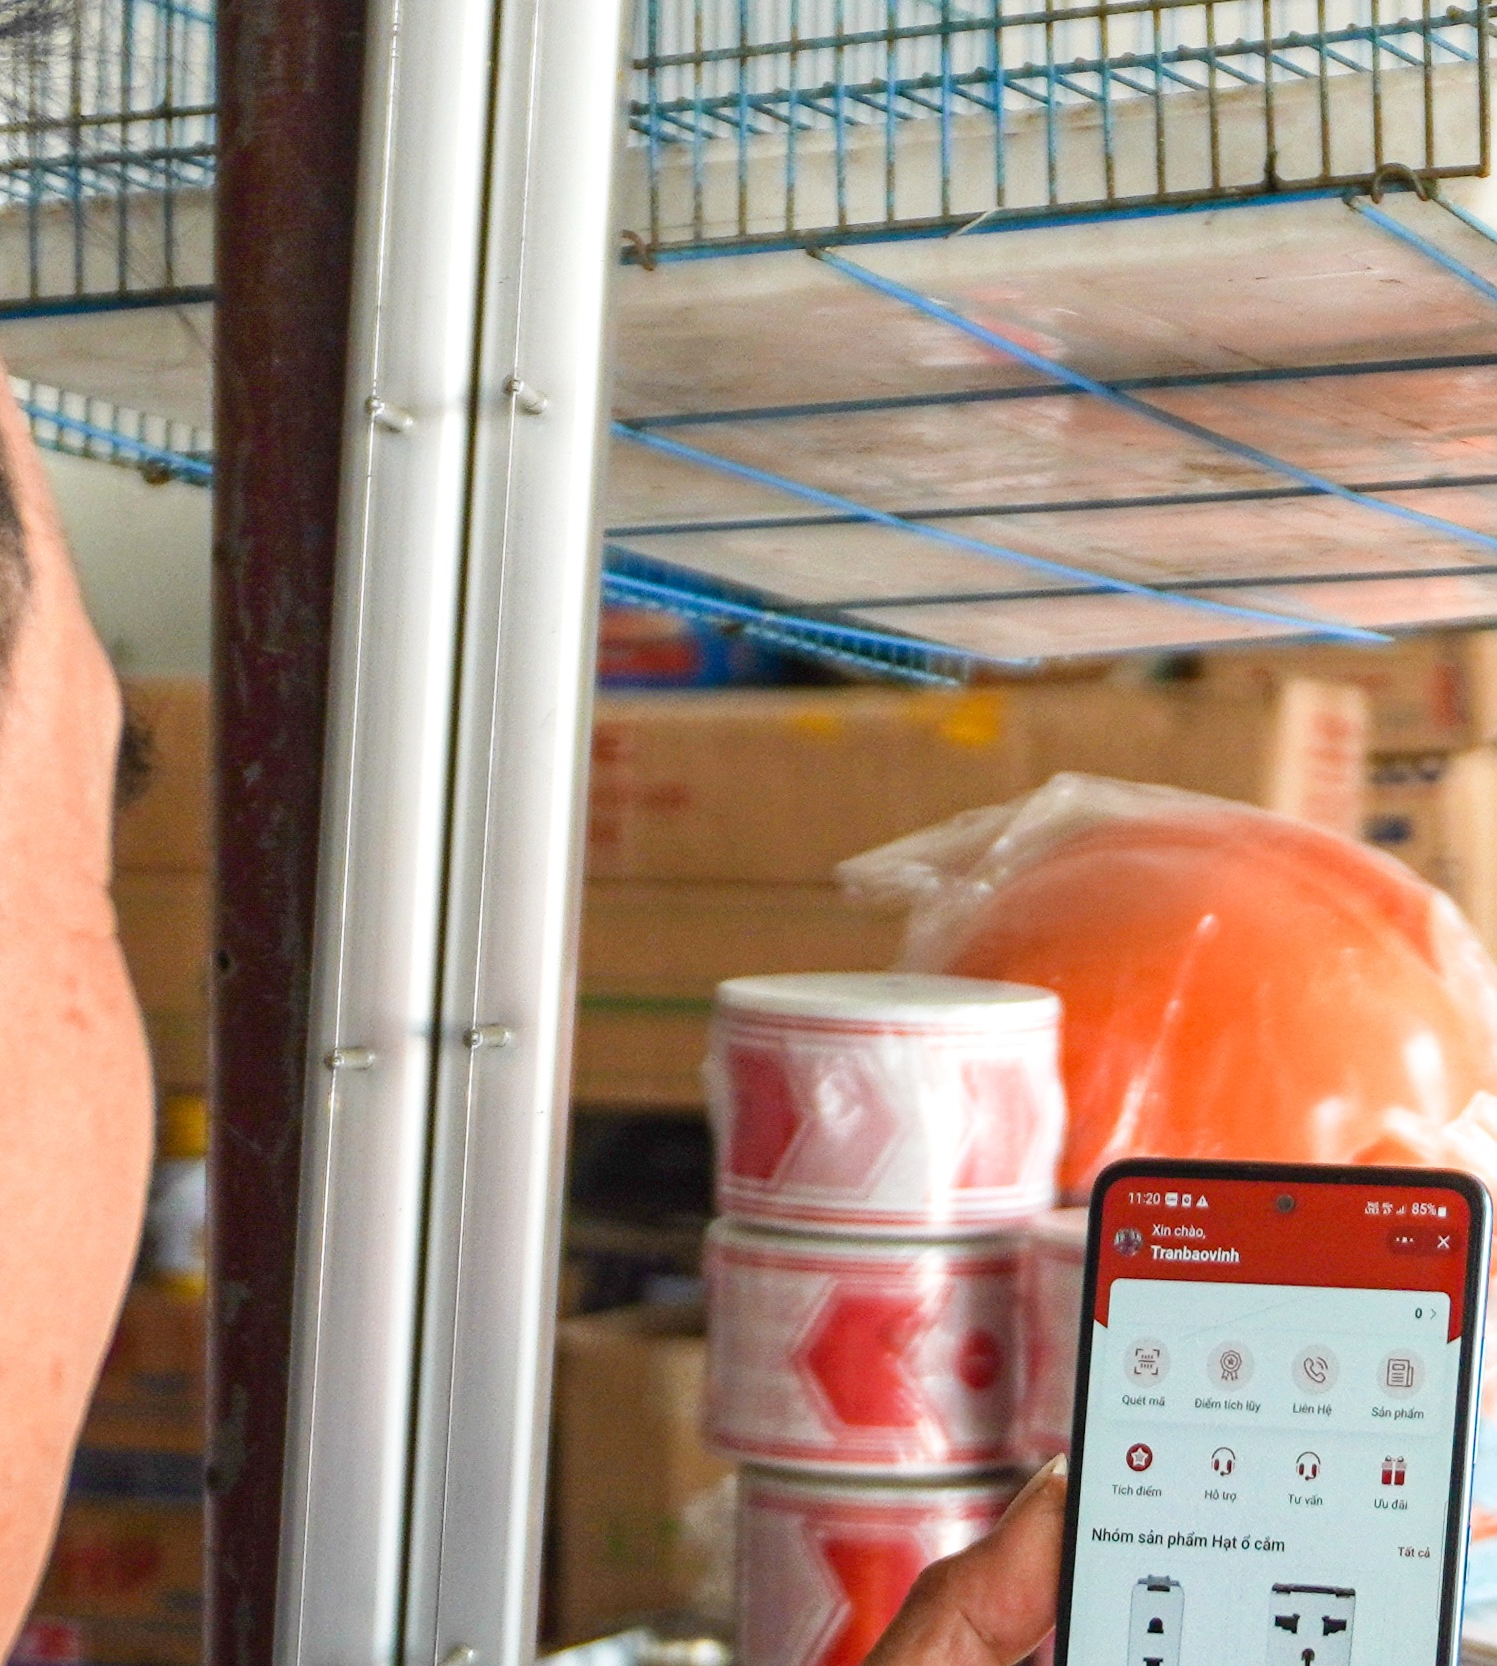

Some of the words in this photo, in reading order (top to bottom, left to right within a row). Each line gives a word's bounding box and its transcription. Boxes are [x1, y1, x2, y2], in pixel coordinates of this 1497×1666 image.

[1129, 1192, 1161, 1204] 11:20
[1411, 1202, 1437, 1216] 85%
[1152, 1224, 1171, 1236] Xin
[1174, 1224, 1206, 1239] chào,
[1150, 1245, 1240, 1263] Tranbaovinh
[1414, 1307, 1423, 1319] 0
[1122, 1395, 1146, 1407] Quét
[1149, 1396, 1165, 1407] mã
[1194, 1398, 1221, 1409] Điểm
[1224, 1400, 1243, 1410] tích
[1246, 1401, 1261, 1414] lũy
[1292, 1403, 1314, 1414] Liên
[1317, 1404, 1333, 1417] Hệ
[1371, 1406, 1391, 1418] Sản
[1394, 1407, 1424, 1421] phẩm
[1112, 1485, 1133, 1496] Tích
[1136, 1486, 1162, 1497] điểm
[1288, 1494, 1302, 1505] Tư
[1374, 1498, 1388, 1509] Ưu
[1091, 1527, 1134, 1543] Nhóm
[1138, 1529, 1163, 1545] sản
[1167, 1531, 1207, 1549] phẩm
[1212, 1534, 1237, 1551] Hạt
[1241, 1534, 1250, 1550] ổ
[1254, 1536, 1285, 1552] cắm
[1398, 1546, 1415, 1558] Tất
[1418, 1546, 1430, 1558] cả
